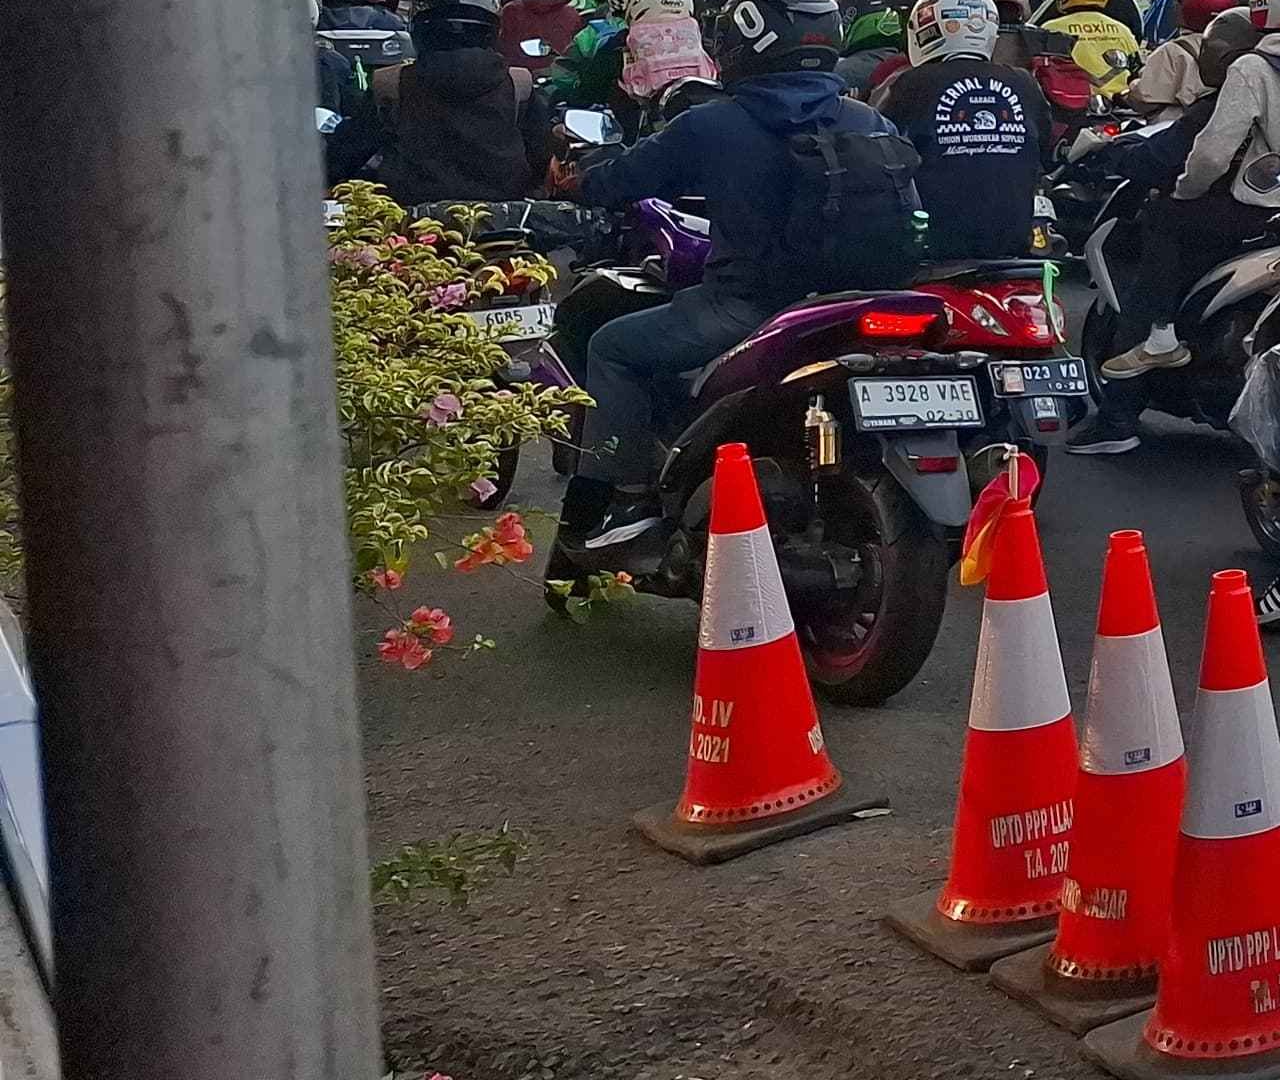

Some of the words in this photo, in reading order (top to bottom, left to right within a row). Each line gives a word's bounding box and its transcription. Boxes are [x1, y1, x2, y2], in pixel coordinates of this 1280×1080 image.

[1068, 20, 1119, 33] maxim
[935, 77, 983, 121] ETERNAL
[990, 78, 1024, 122] WORKS
[861, 386, 871, 402] A
[884, 385, 929, 402] 3928
[936, 383, 973, 401] VAE
[711, 700, 734, 728] IV
[696, 733, 730, 763] 2021
[991, 813, 1023, 848] UPTD
[1025, 808, 1047, 841] PPP
[1024, 848, 1048, 879] T.A.
[1208, 936, 1244, 975] UPTD
[1246, 930, 1271, 968] PPP
